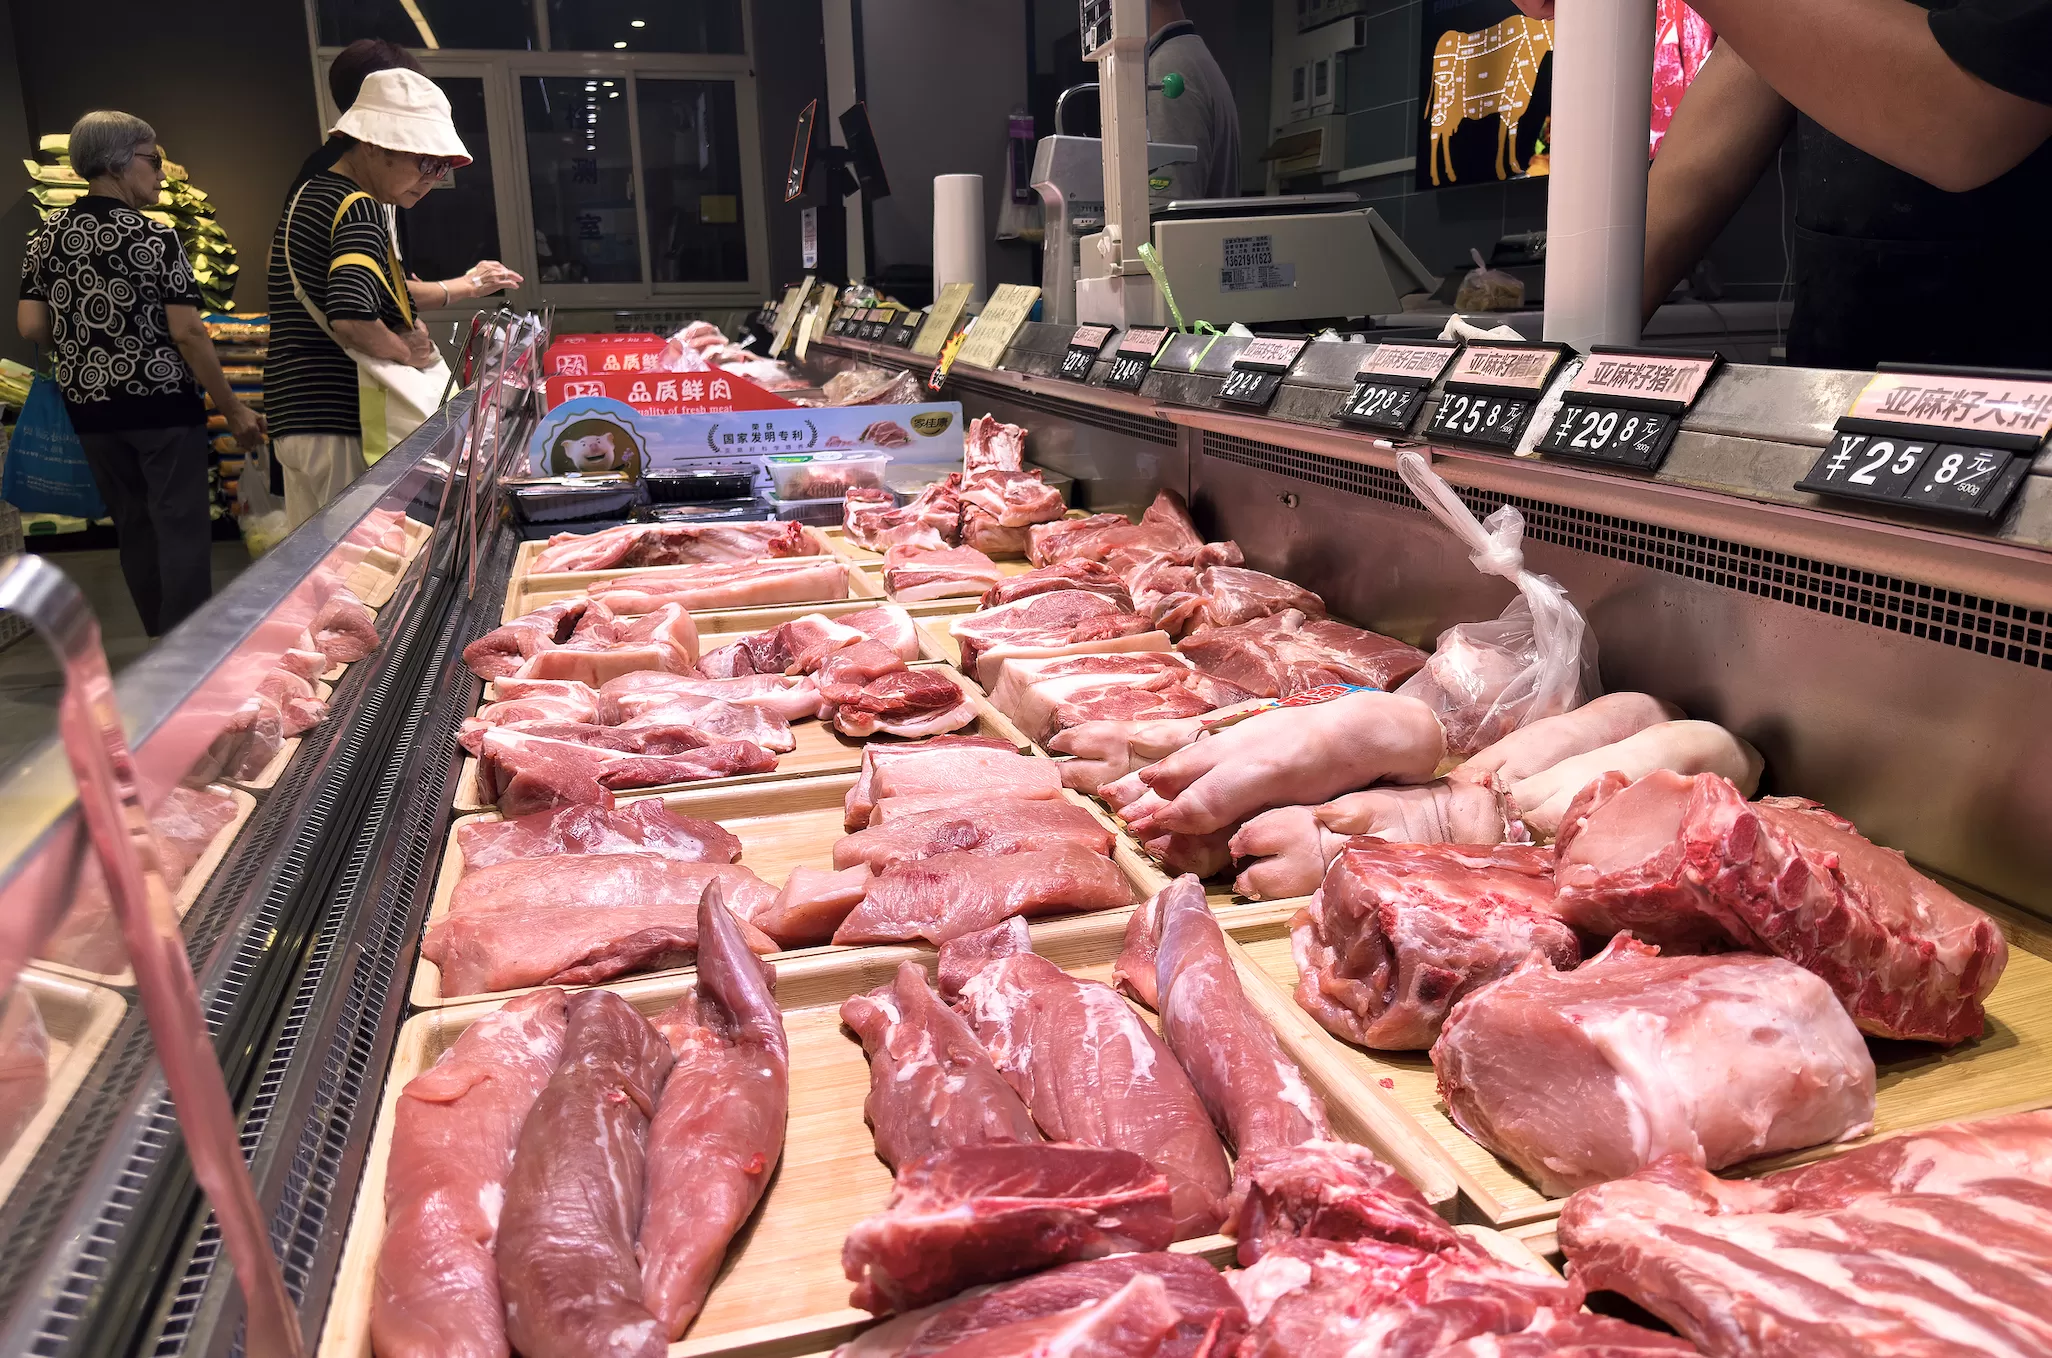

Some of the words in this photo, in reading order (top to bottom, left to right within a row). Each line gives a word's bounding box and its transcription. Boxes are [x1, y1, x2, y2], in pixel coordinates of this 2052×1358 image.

[603, 353, 662, 372] 品质鲜
[1368, 348, 1450, 372] 亚麻籽后腿肉
[1464, 351, 1548, 377] 亚麻籽精肉
[1219, 370, 1263, 395] ¥22.8
[1587, 361, 1700, 393] 亚麻籽猪爪
[628, 378, 732, 403] 品质鲜肉
[1343, 383, 1398, 416] ¥22.8
[637, 406, 665, 416] uality
[668, 405, 678, 415] of
[682, 405, 706, 414] fresh
[709, 404, 733, 413] meat
[1434, 393, 1502, 433] ¥25.8
[1875, 386, 2052, 430] 亚麻籽大排
[723, 429, 803, 445] 国家发明专利
[1554, 407, 1640, 449] ¥29.8
[1826, 435, 1965, 493] ¥25.8
